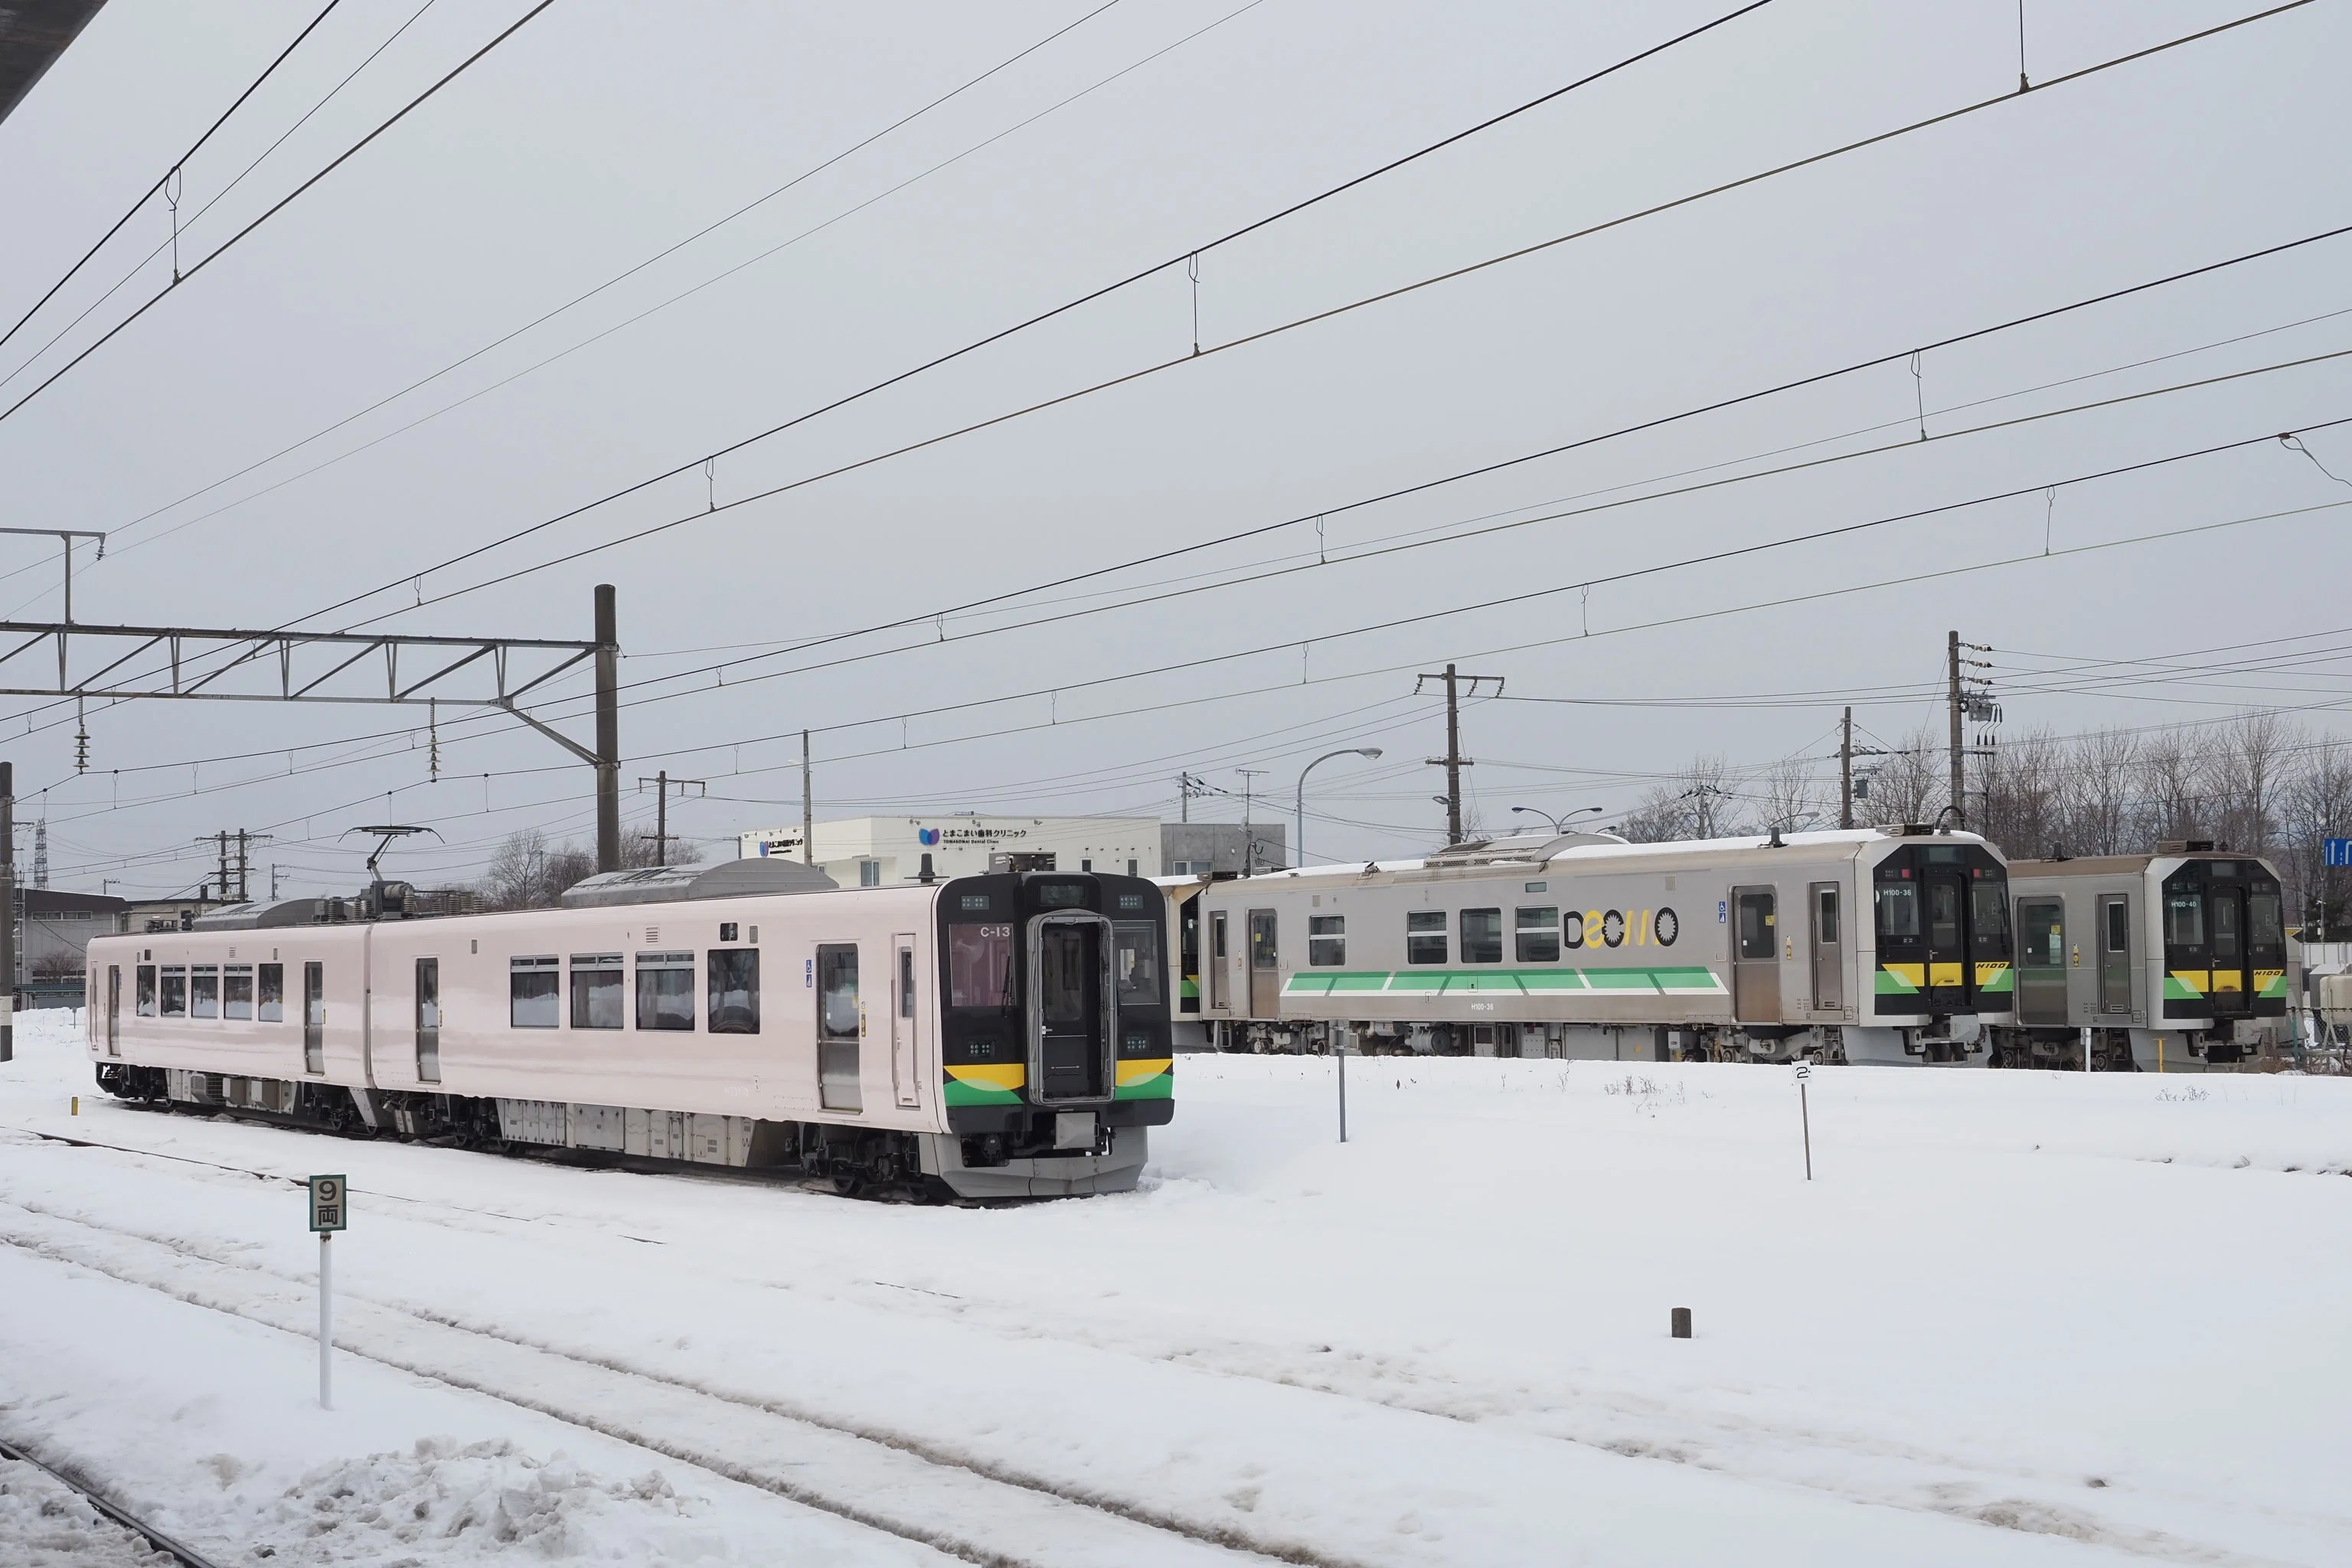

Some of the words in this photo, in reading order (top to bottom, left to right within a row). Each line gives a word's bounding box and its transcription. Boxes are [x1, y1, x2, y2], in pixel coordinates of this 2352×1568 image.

[942, 829, 1027, 838] とまこまい歯科クリニック
[980, 926, 1011, 937] C-13
